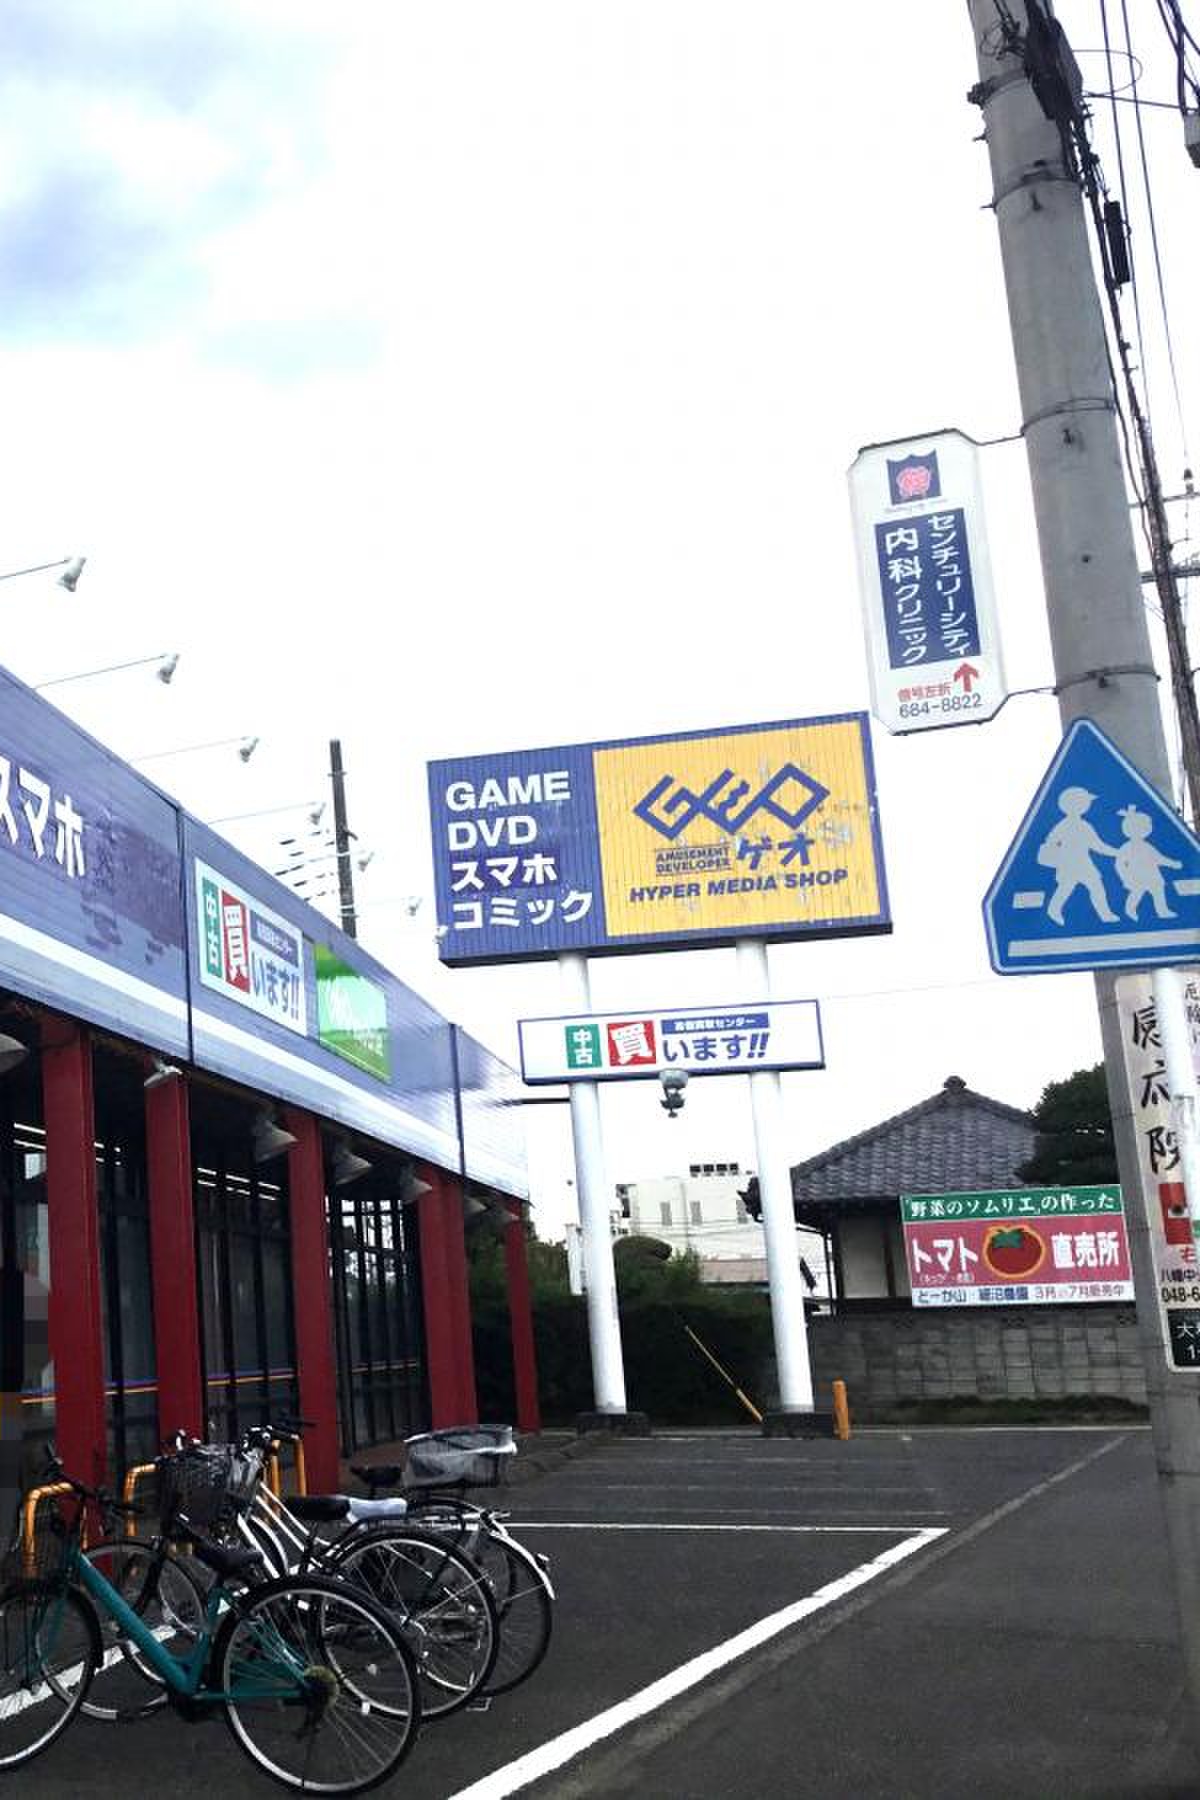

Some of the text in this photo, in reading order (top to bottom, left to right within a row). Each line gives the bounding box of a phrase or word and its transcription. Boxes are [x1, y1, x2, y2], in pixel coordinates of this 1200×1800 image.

[885, 527, 927, 665] 内科クリニック
[899, 692, 983, 718] 684-8822
[446, 771, 571, 812] GAME
[448, 815, 538, 851] DVD
[736, 832, 816, 871] ゲオ
[451, 854, 558, 892] スマホ
[629, 868, 848, 904] HYPER MEDIA SHOP
[453, 889, 593, 930] コミック
[573, 1028, 594, 1065] 中古
[911, 1236, 979, 1273] トマト
[1051, 1231, 1120, 1269] 直売所
